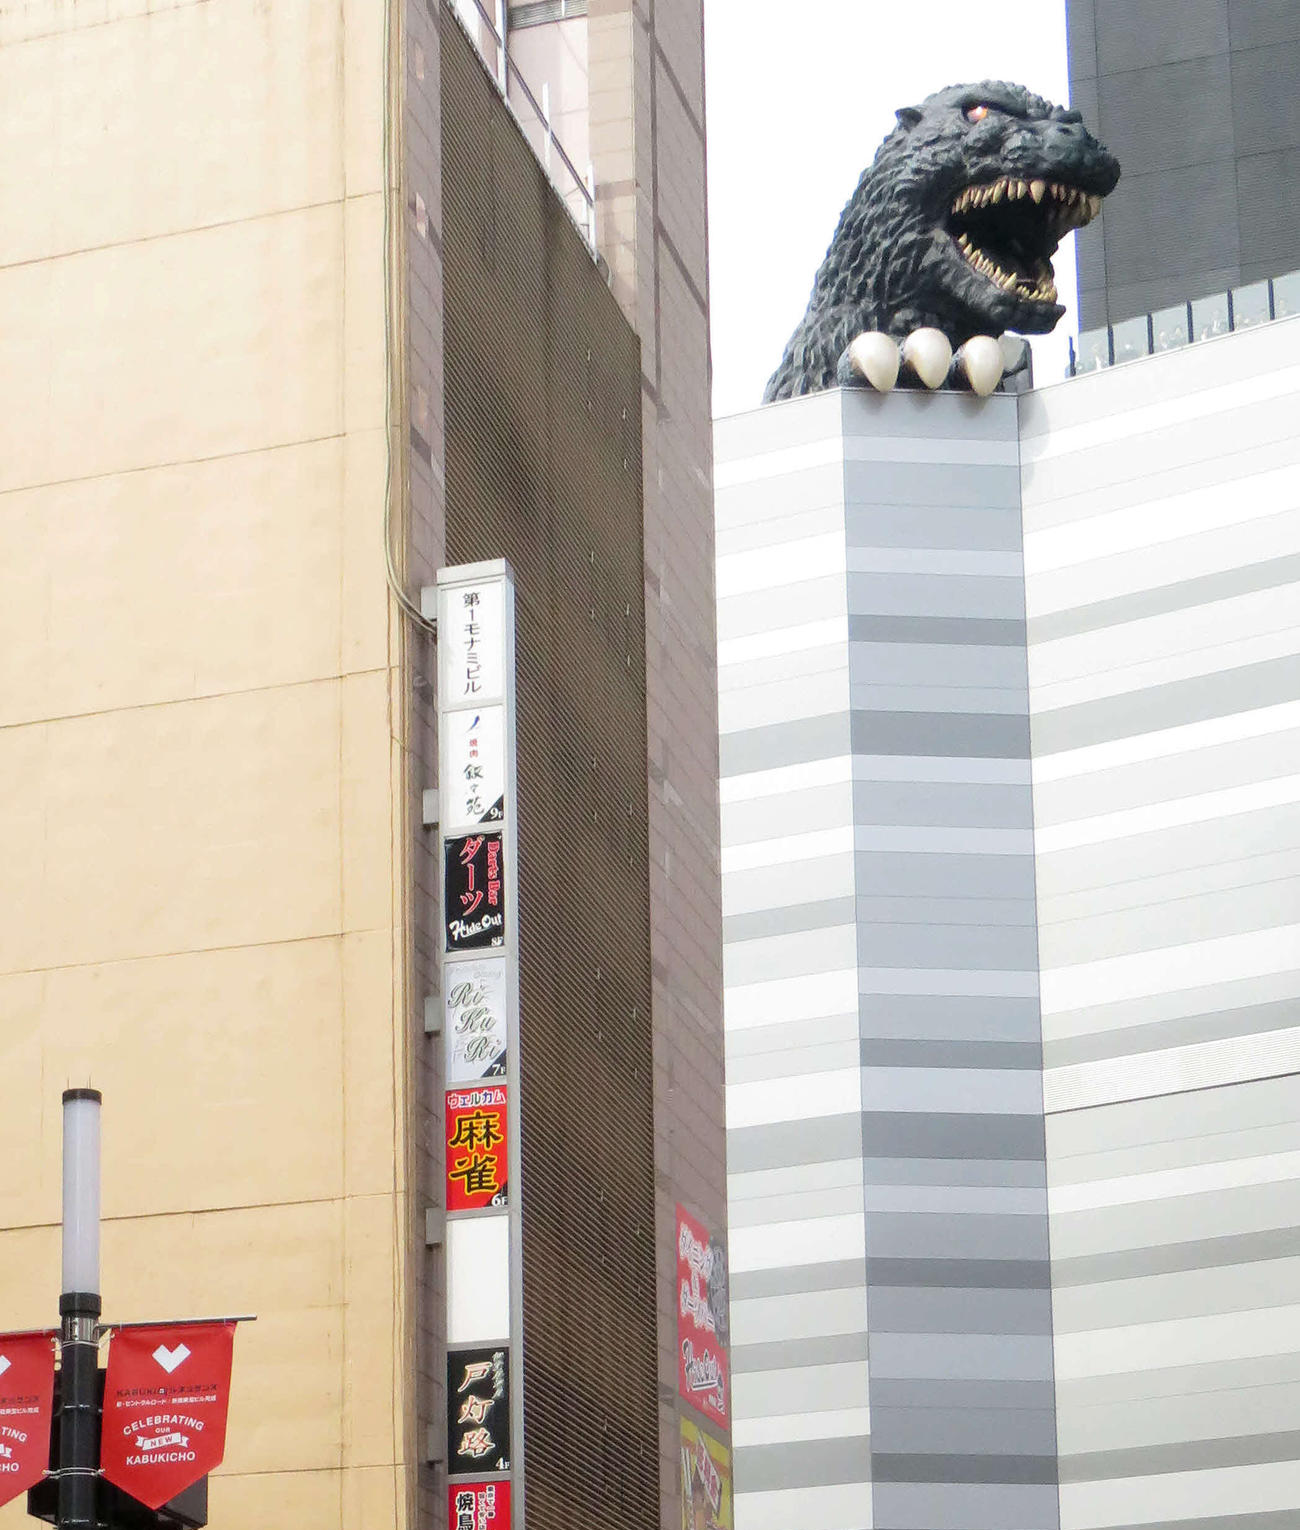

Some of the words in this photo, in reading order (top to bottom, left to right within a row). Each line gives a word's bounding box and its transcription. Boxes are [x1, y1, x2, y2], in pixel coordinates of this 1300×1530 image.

[490, 807, 504, 820] 9F
[487, 841, 500, 880] Darts
[459, 835, 484, 916] ダーツ
[487, 880, 500, 906] Bar
[449, 918, 482, 941] Hide
[481, 912, 502, 930] Out
[491, 935, 504, 947] 8F
[492, 1063, 506, 1077] 7F
[448, 1089, 506, 1109] ウェルカム
[448, 1110, 504, 1196] 麻雀
[491, 1192, 508, 1207] 6F
[123, 1414, 205, 1436] CELEBRATING
[0, 1426, 28, 1443] TING
[150, 1435, 174, 1448] NEW
[126, 1451, 196, 1466] KABUKICHO
[495, 1457, 511, 1471] 4F
